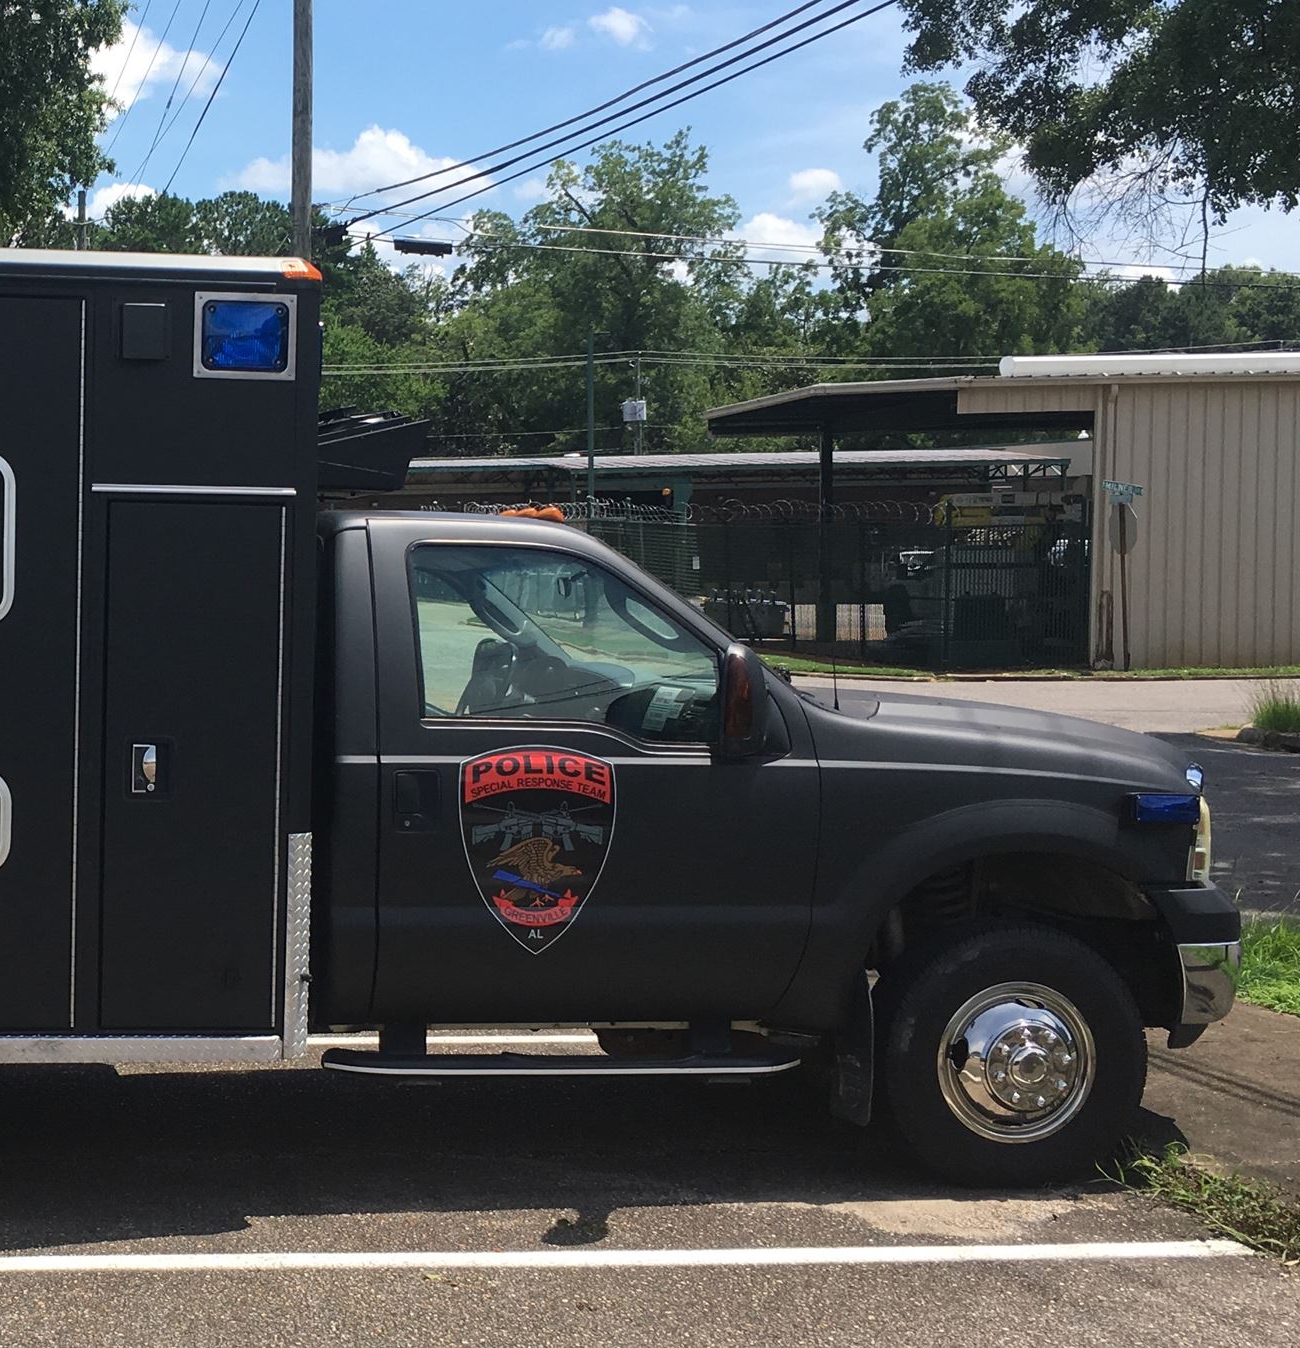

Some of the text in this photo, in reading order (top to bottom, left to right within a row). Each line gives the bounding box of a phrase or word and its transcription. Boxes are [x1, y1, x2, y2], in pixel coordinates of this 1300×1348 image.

[472, 754, 606, 786] POLICE
[471, 776, 607, 800] SPECIAL RESPONSE TEAM
[504, 905, 568, 925] GREENVILLE
[528, 928, 544, 939] AL
